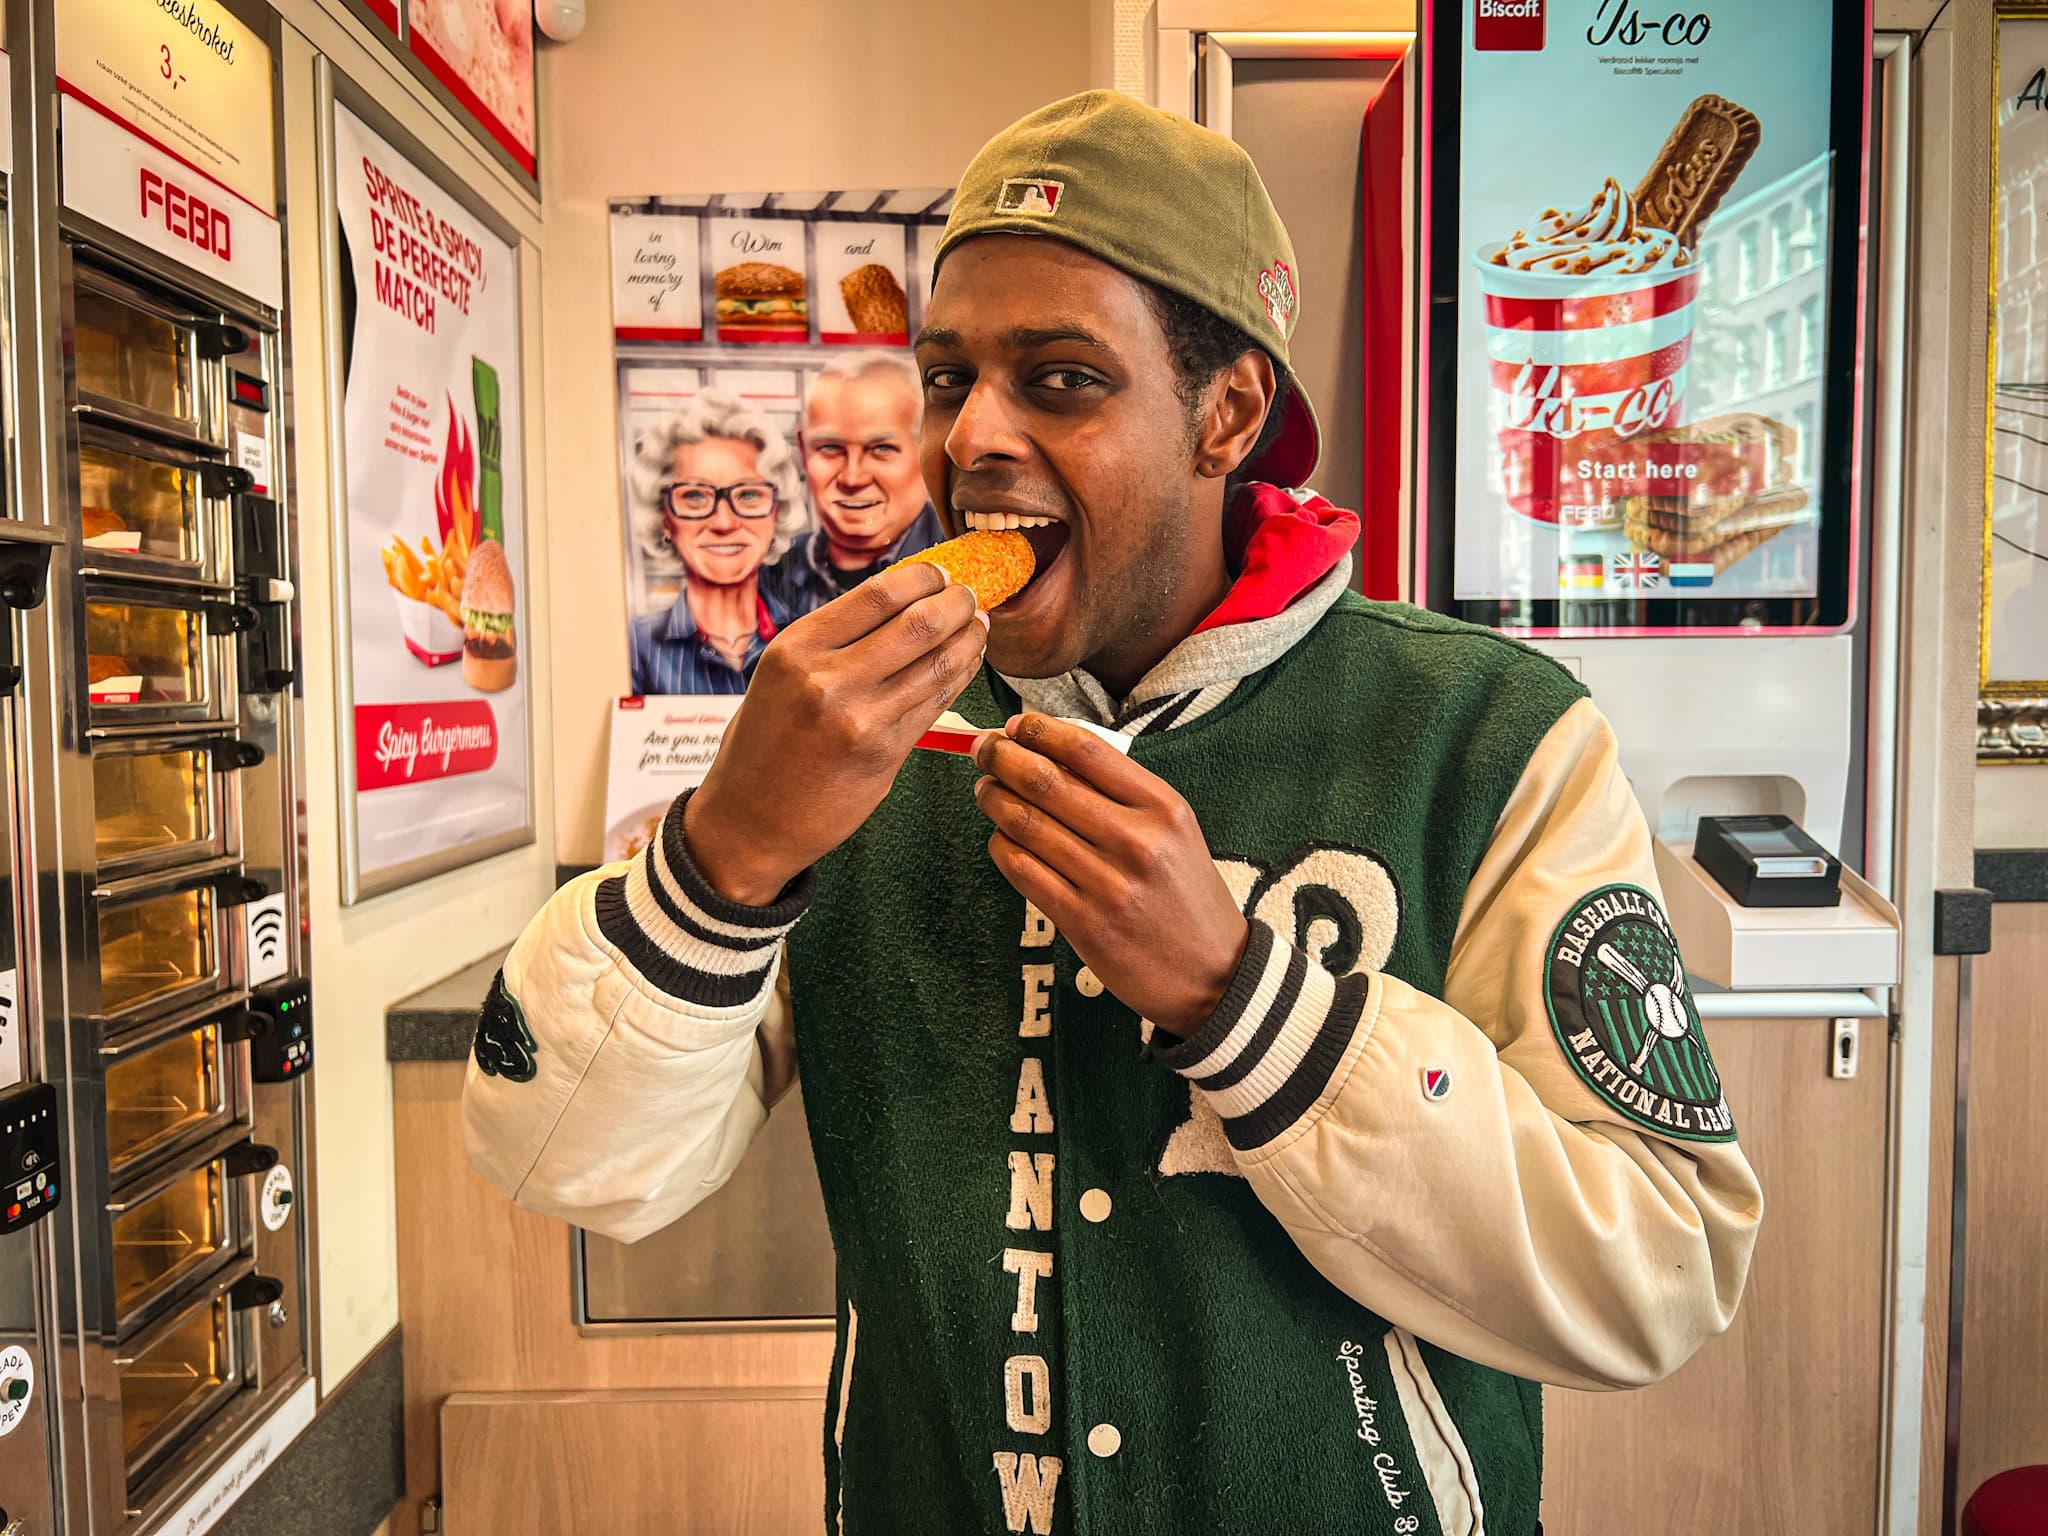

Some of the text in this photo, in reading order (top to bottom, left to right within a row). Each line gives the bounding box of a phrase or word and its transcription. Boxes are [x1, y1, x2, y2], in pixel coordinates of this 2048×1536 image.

[140, 167, 231, 262] FEBO
[363, 156, 429, 239] SPRITE
[427, 208, 442, 248] &
[648, 231, 662, 243] in
[730, 231, 783, 254] Wim
[845, 239, 876, 255] and
[370, 207, 471, 316] DE PERFECTE
[634, 248, 676, 271] loving
[627, 272, 684, 292] memory
[375, 260, 435, 335] MATCH
[649, 288, 666, 312] of
[1577, 459, 1698, 479] Start here
[374, 716, 492, 778] Spicy Burgermenu
[644, 730, 721, 751] Are you re
[1558, 891, 1646, 968] BASEBALL
[1568, 1027, 1691, 1129] NATIONAL
[0, 1399, 22, 1427] PEN
[1336, 1340, 1381, 1446] Sporting
[1373, 1453, 1411, 1510] Club
